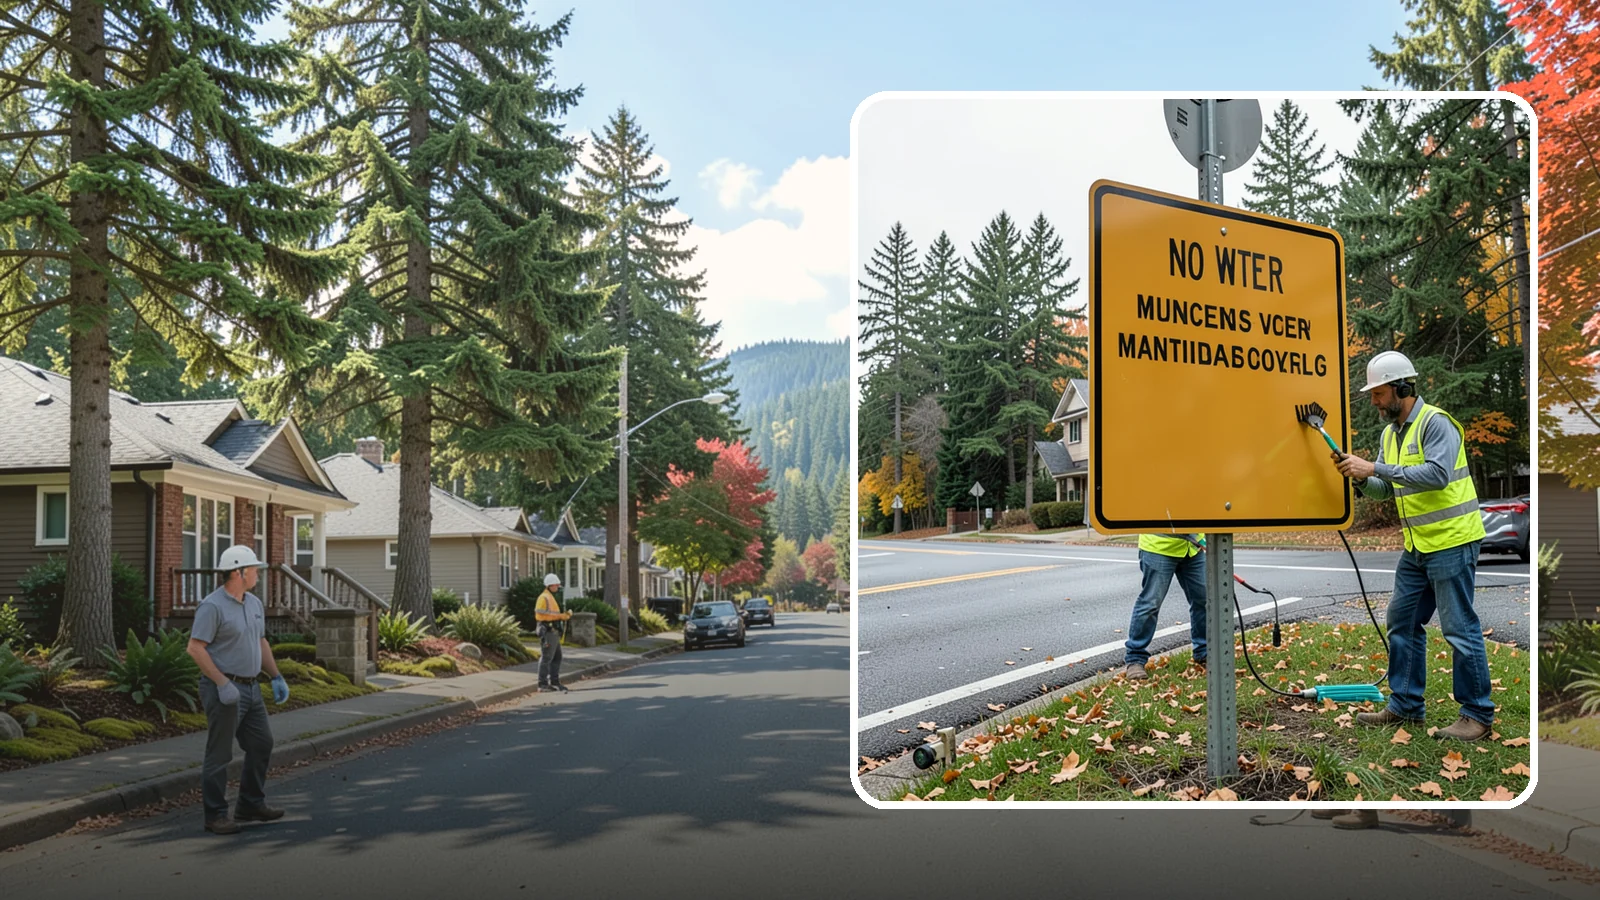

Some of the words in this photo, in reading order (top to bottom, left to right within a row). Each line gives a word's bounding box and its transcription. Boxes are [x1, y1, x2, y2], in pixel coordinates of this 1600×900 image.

[1170, 238, 1204, 281] NO
[1214, 245, 1284, 295] WTER
[1137, 293, 1252, 333] MUNCENS
